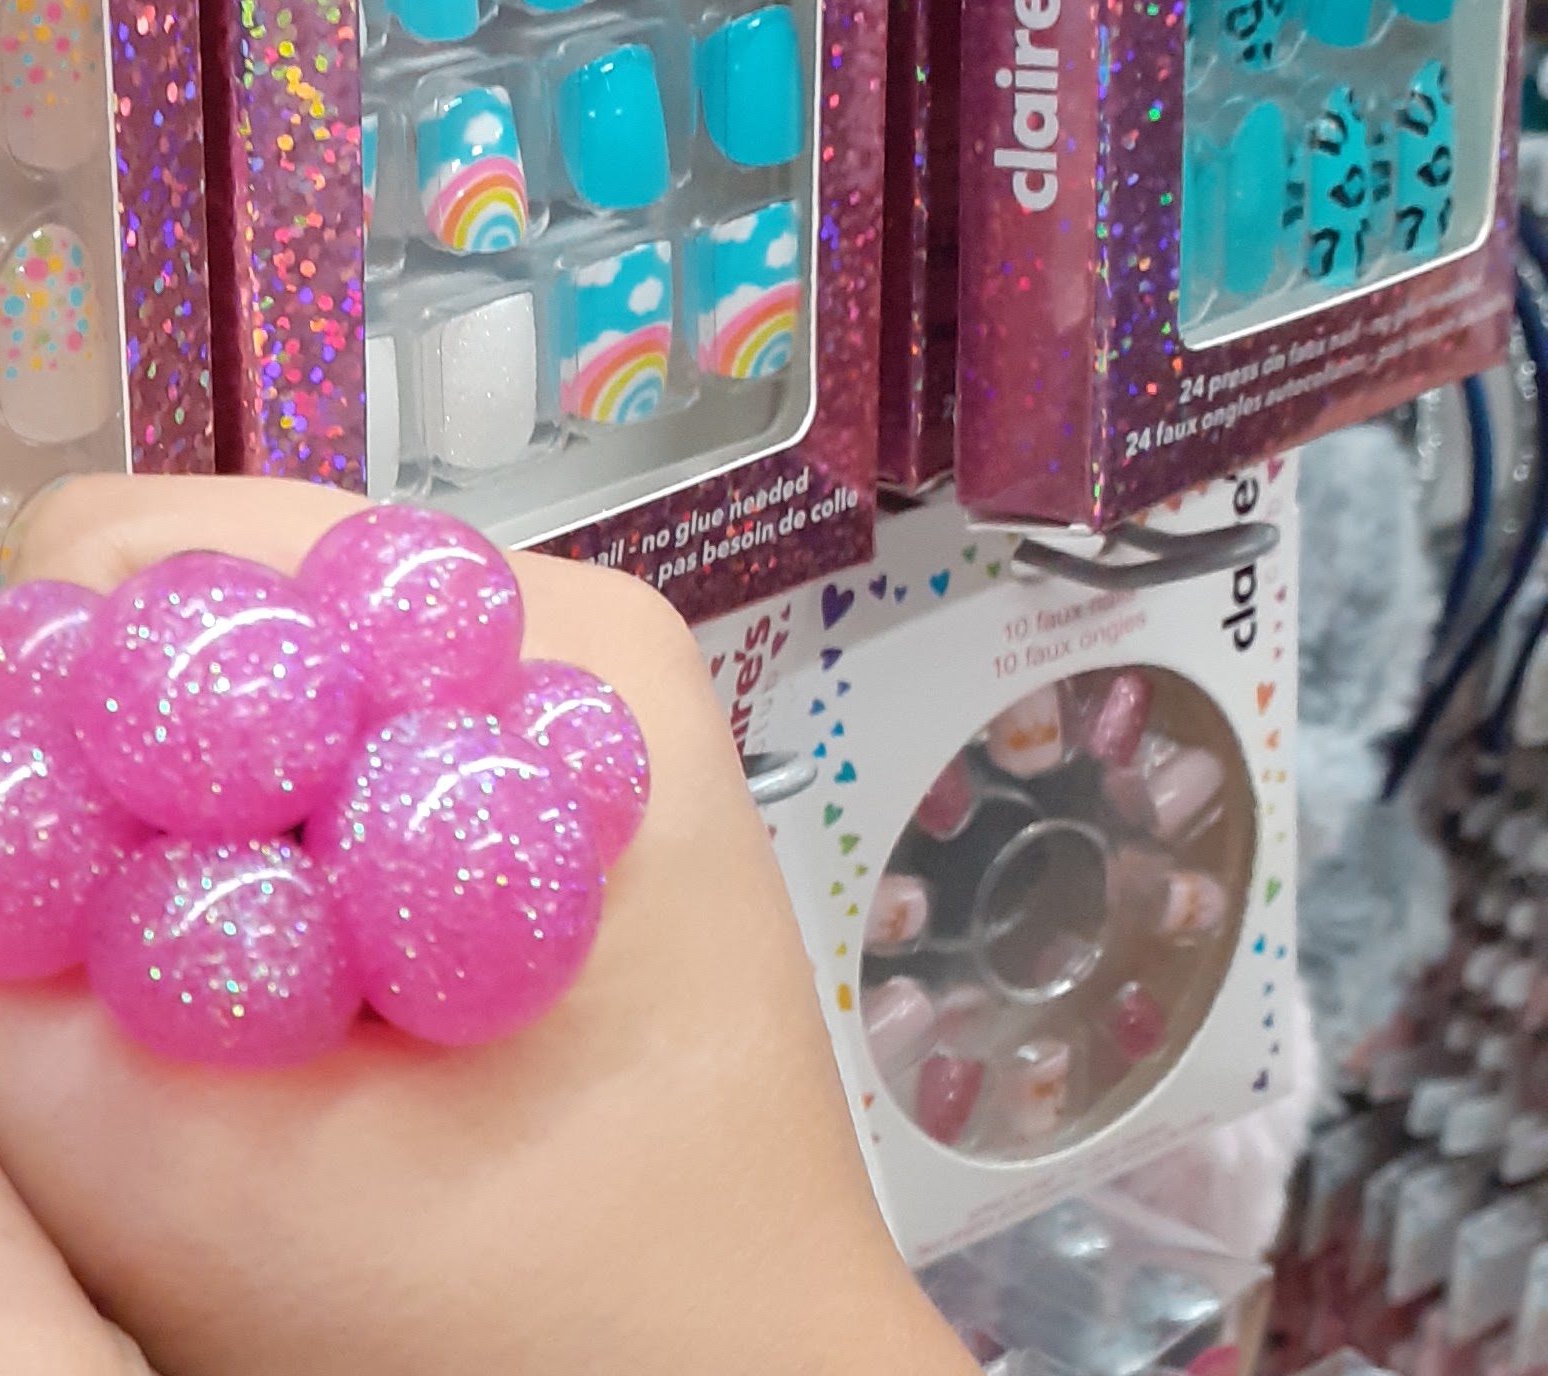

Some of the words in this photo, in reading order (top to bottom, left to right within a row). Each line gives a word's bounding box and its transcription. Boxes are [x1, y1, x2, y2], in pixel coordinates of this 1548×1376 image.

[1178, 378, 1203, 405] 24
[1125, 433, 1152, 460] 24
[1156, 415, 1198, 447] faux
[642, 529, 670, 555] no
[675, 507, 724, 549] glue
[729, 466, 810, 522] needed
[657, 553, 697, 590] pas
[702, 520, 774, 566] besoin
[778, 505, 807, 537] de
[810, 486, 859, 523] colle
